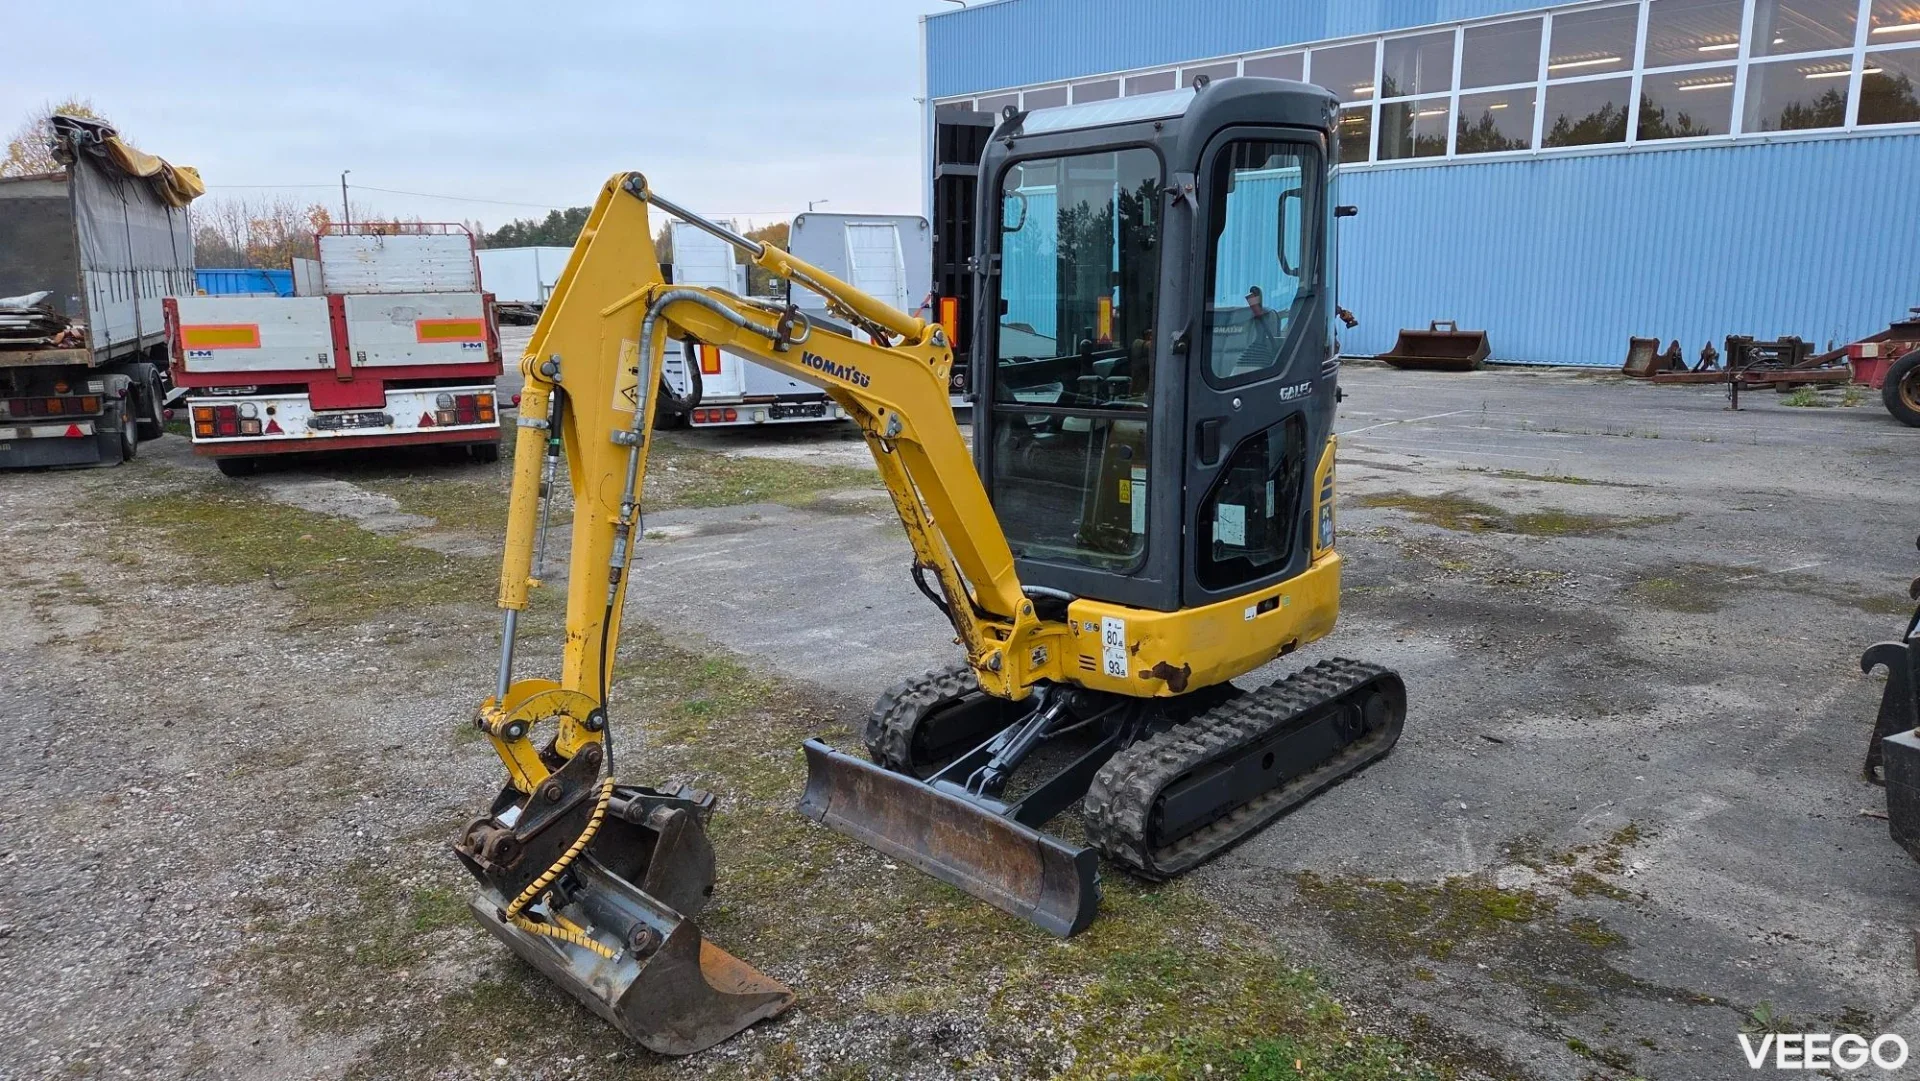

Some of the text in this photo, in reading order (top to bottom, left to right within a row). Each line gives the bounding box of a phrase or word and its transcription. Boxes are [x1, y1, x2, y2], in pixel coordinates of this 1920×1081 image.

[801, 350, 871, 388] KOMATSU
[1106, 630, 1118, 646] 80
[1108, 660, 1120, 675] 93
